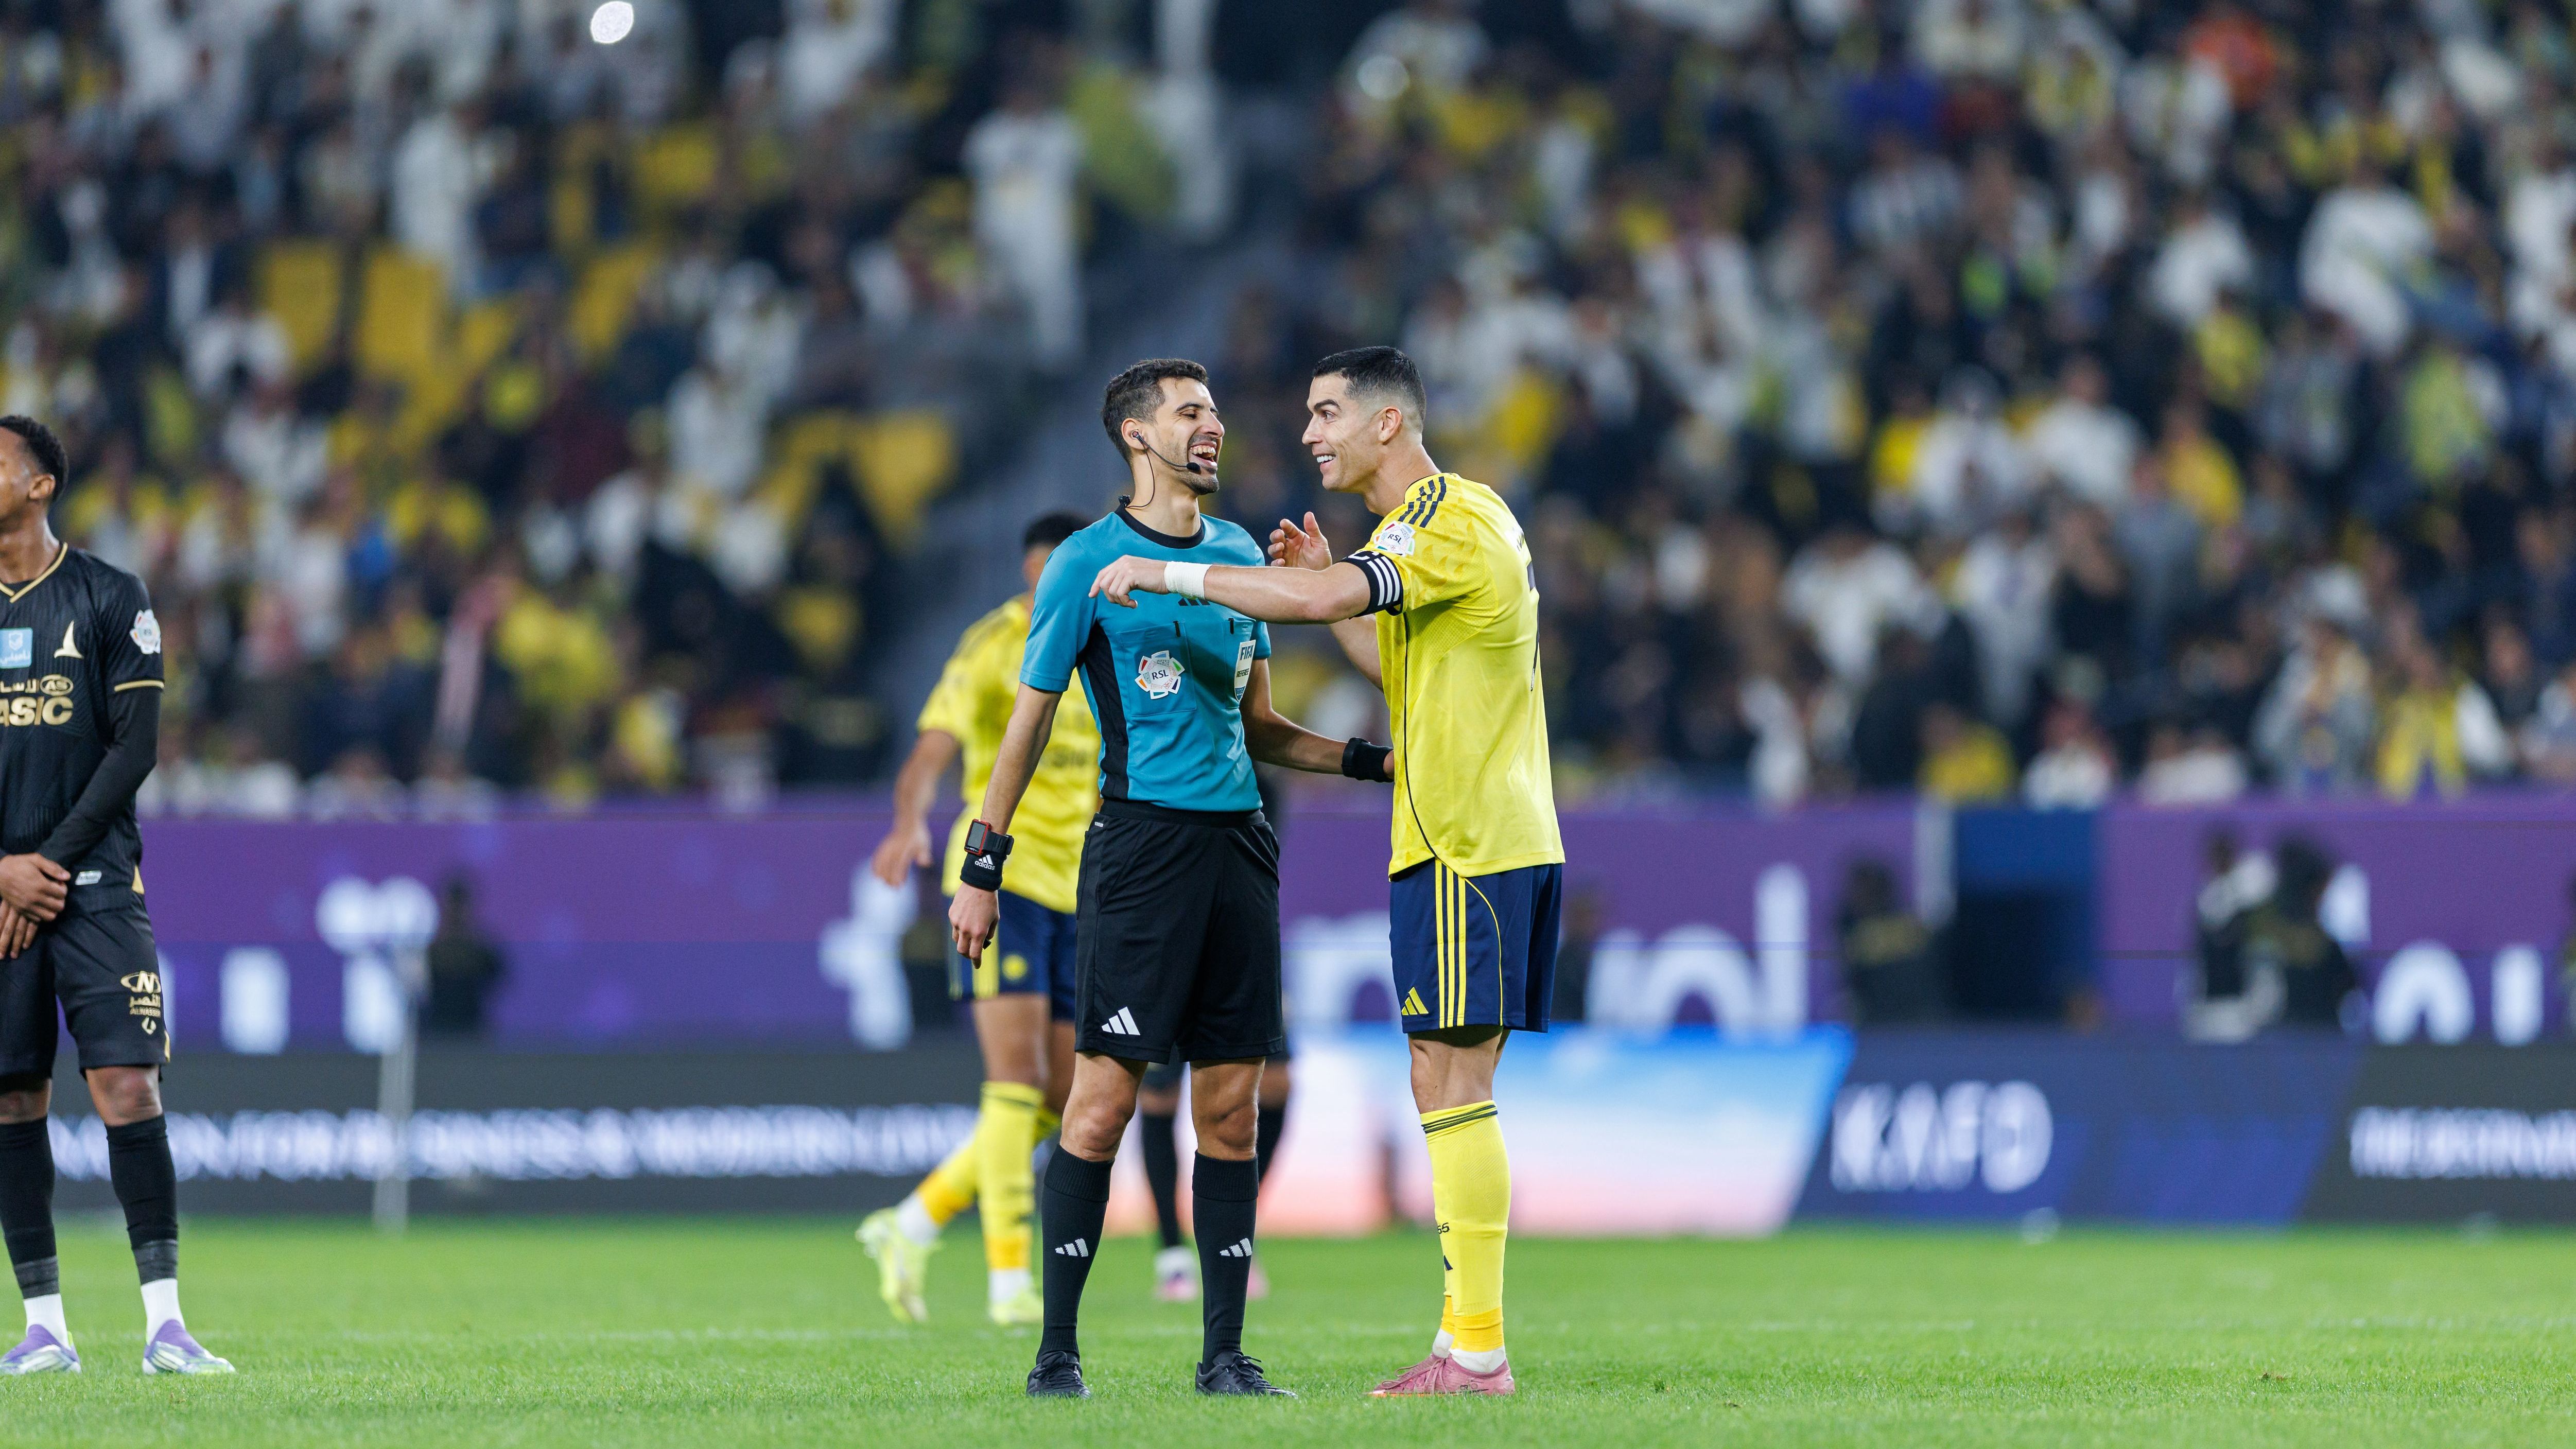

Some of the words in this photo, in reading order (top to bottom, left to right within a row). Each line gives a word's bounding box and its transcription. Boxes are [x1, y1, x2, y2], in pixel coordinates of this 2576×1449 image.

[1387, 533, 1402, 545] RSL
[1240, 645, 1254, 660] FIFA
[1152, 669, 1169, 680] RSL
[974, 860, 996, 870] adidas
